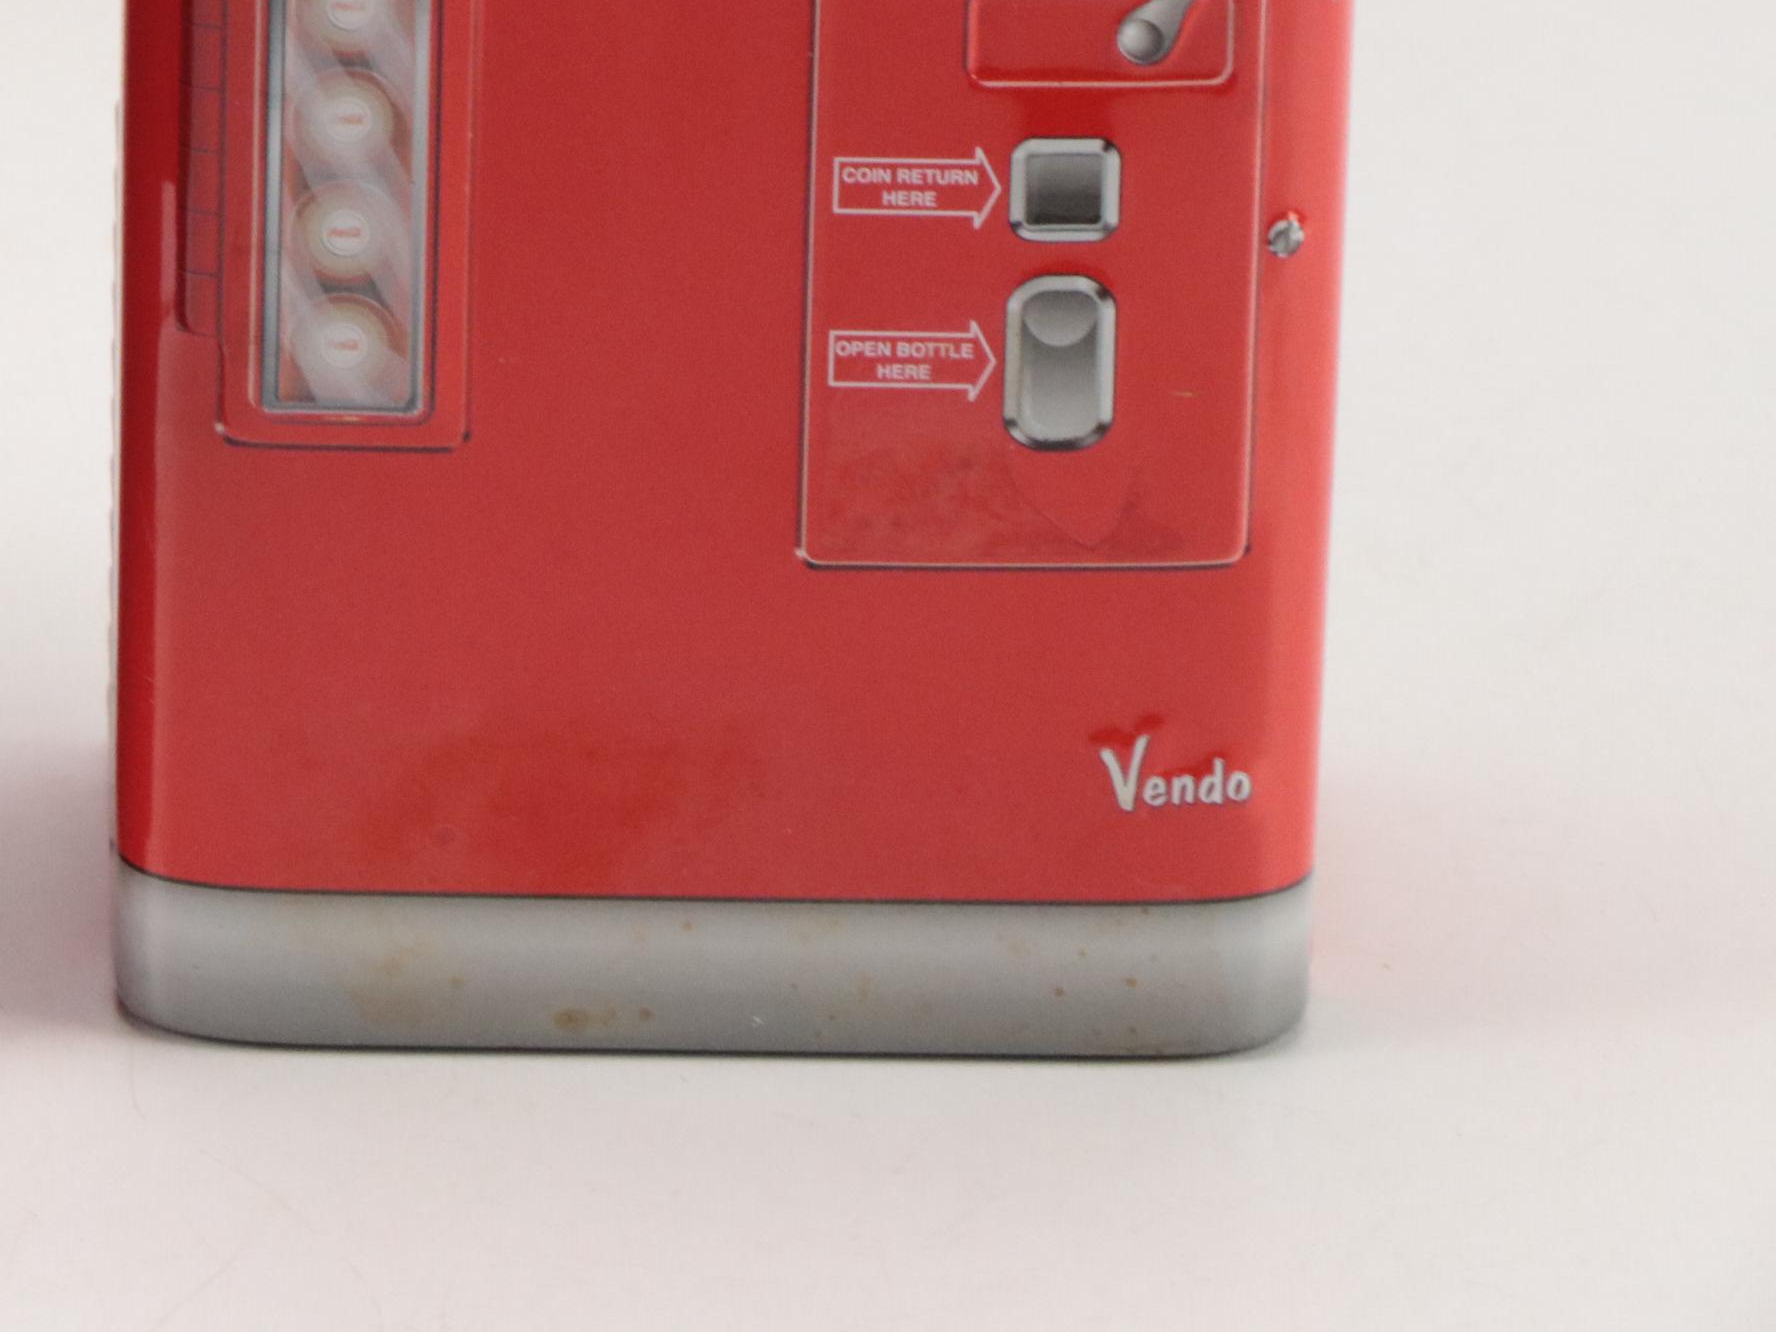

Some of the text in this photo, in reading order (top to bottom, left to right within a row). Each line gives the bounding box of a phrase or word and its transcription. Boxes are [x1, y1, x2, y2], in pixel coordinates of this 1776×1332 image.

[841, 167, 979, 185] COIN RETURN
[881, 190, 938, 208] HERE
[834, 340, 975, 359] OPEN BOTTLE
[876, 362, 932, 381] HERE
[1099, 734, 1253, 812] Vendo
